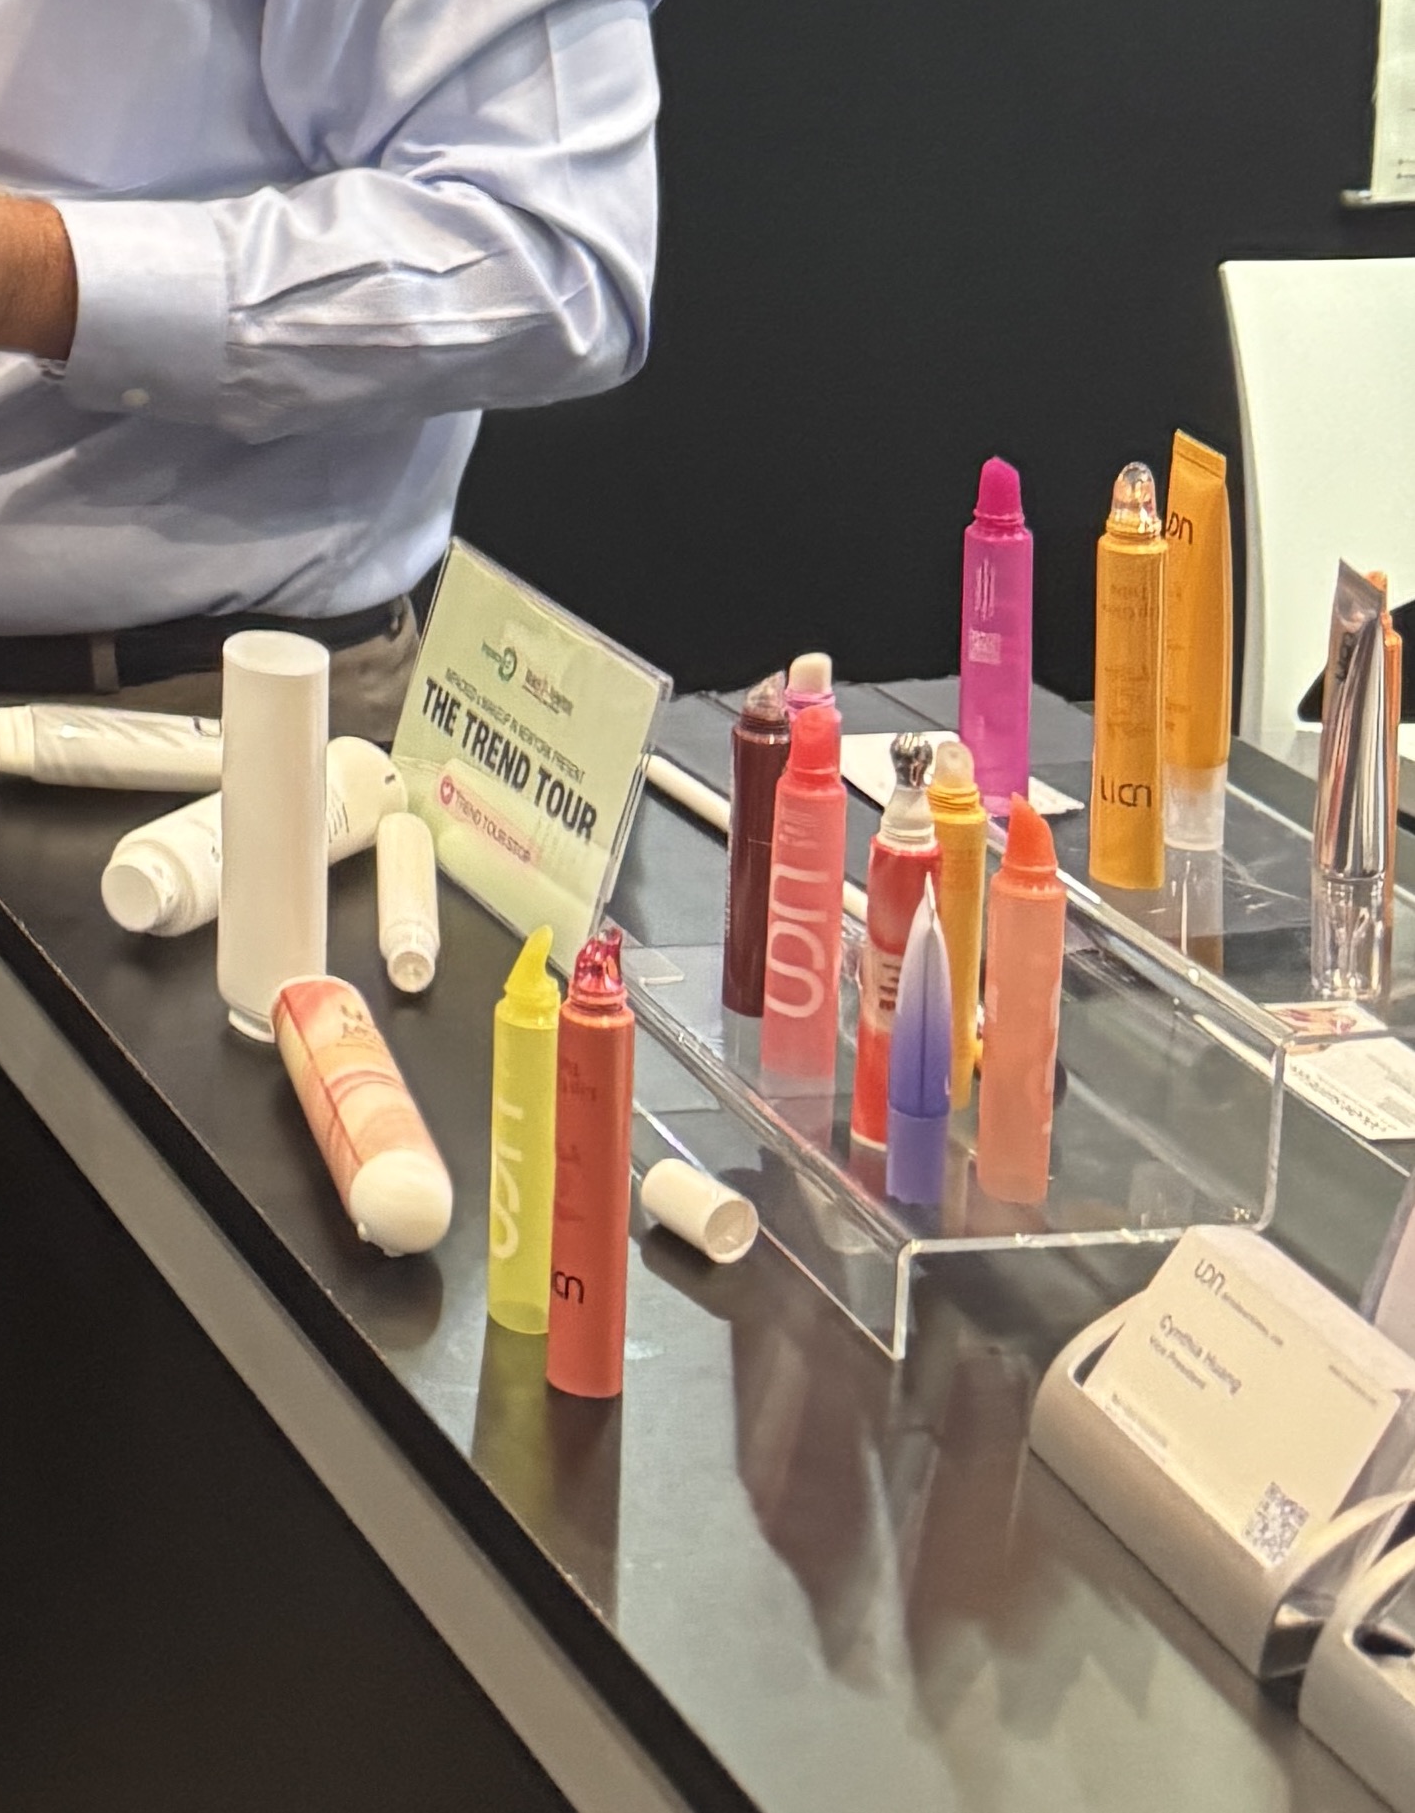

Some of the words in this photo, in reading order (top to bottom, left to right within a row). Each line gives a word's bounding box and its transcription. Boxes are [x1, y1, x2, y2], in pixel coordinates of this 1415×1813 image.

[422, 676, 462, 738] THE
[460, 709, 531, 793] TREND
[533, 767, 598, 843] TOUR
[454, 790, 481, 826] TREND
